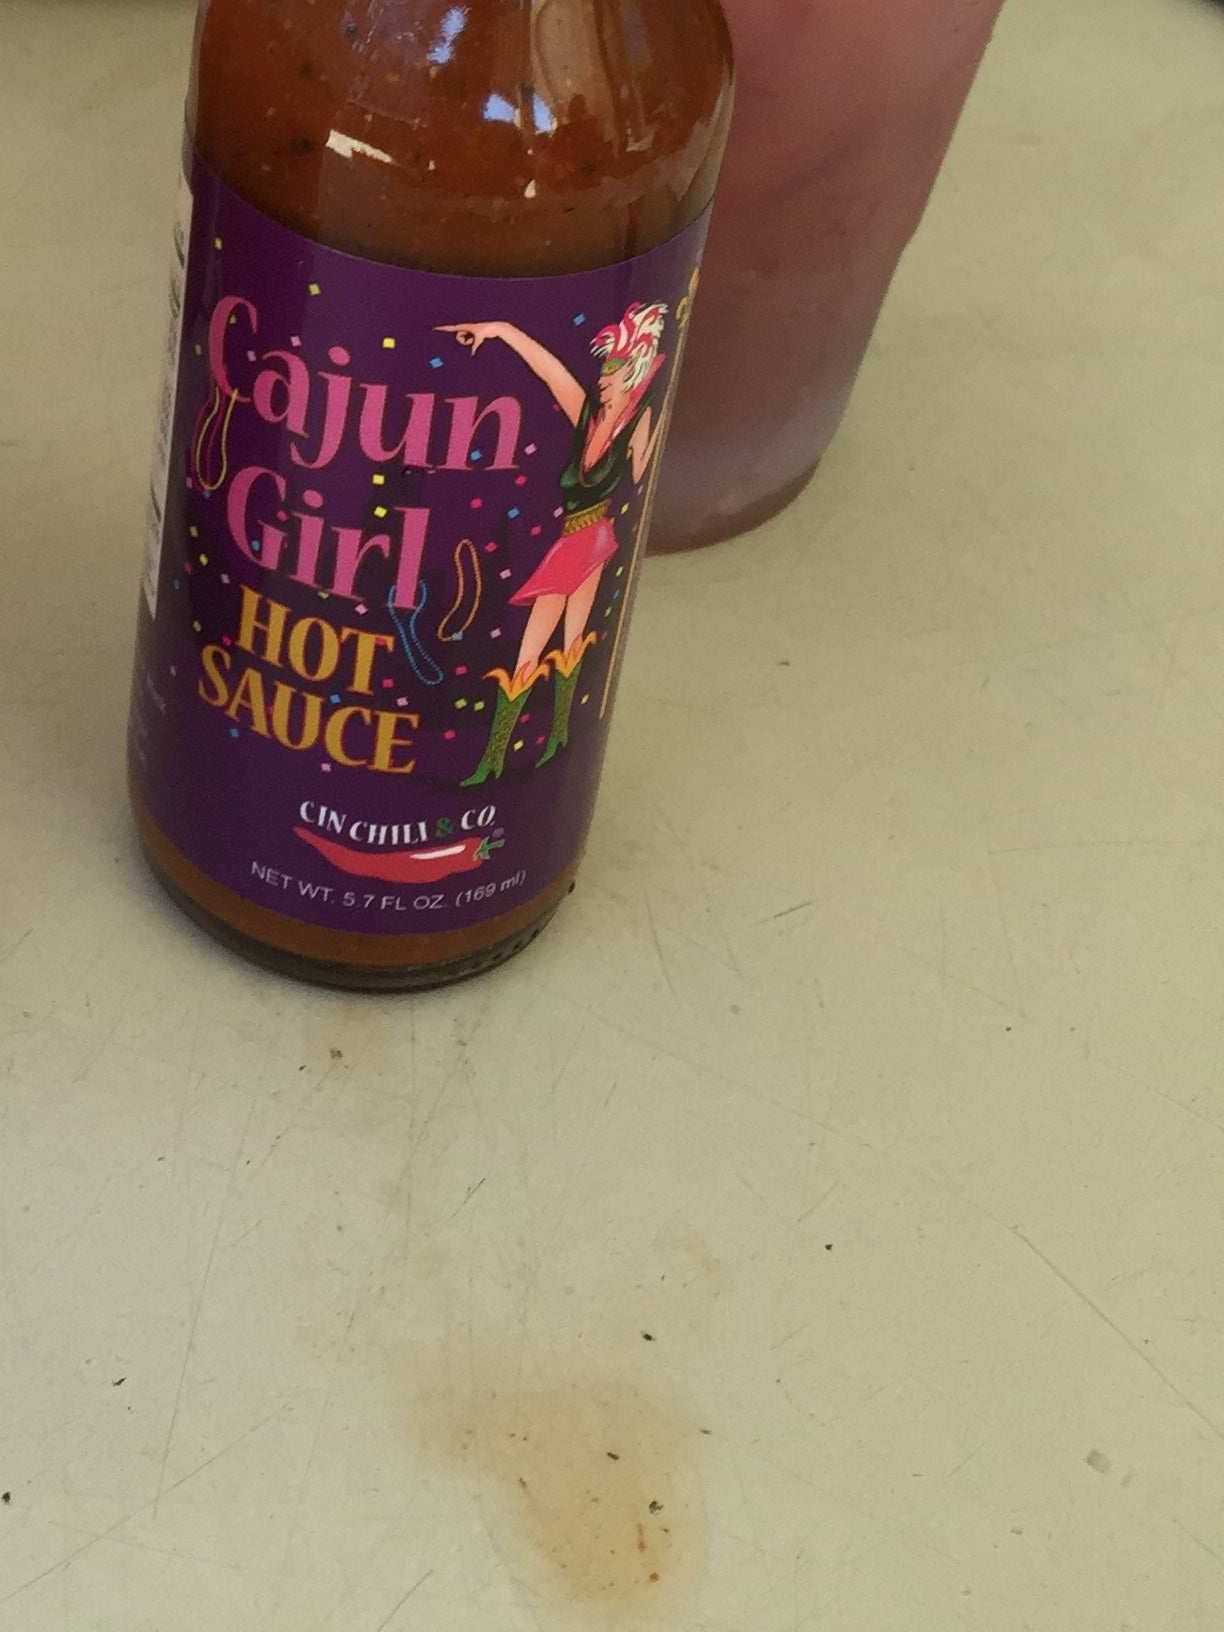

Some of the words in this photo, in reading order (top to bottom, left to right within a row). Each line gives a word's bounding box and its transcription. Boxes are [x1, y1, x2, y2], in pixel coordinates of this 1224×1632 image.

[208, 295, 521, 471] Cajun
[227, 466, 430, 609] Girl
[235, 584, 395, 696] HOT
[198, 644, 419, 774] SAUCE
[299, 800, 348, 834] CIN
[349, 820, 429, 845] CHILI
[251, 860, 293, 889] NET
[297, 879, 335, 904] WT.
[379, 895, 408, 911] FL
